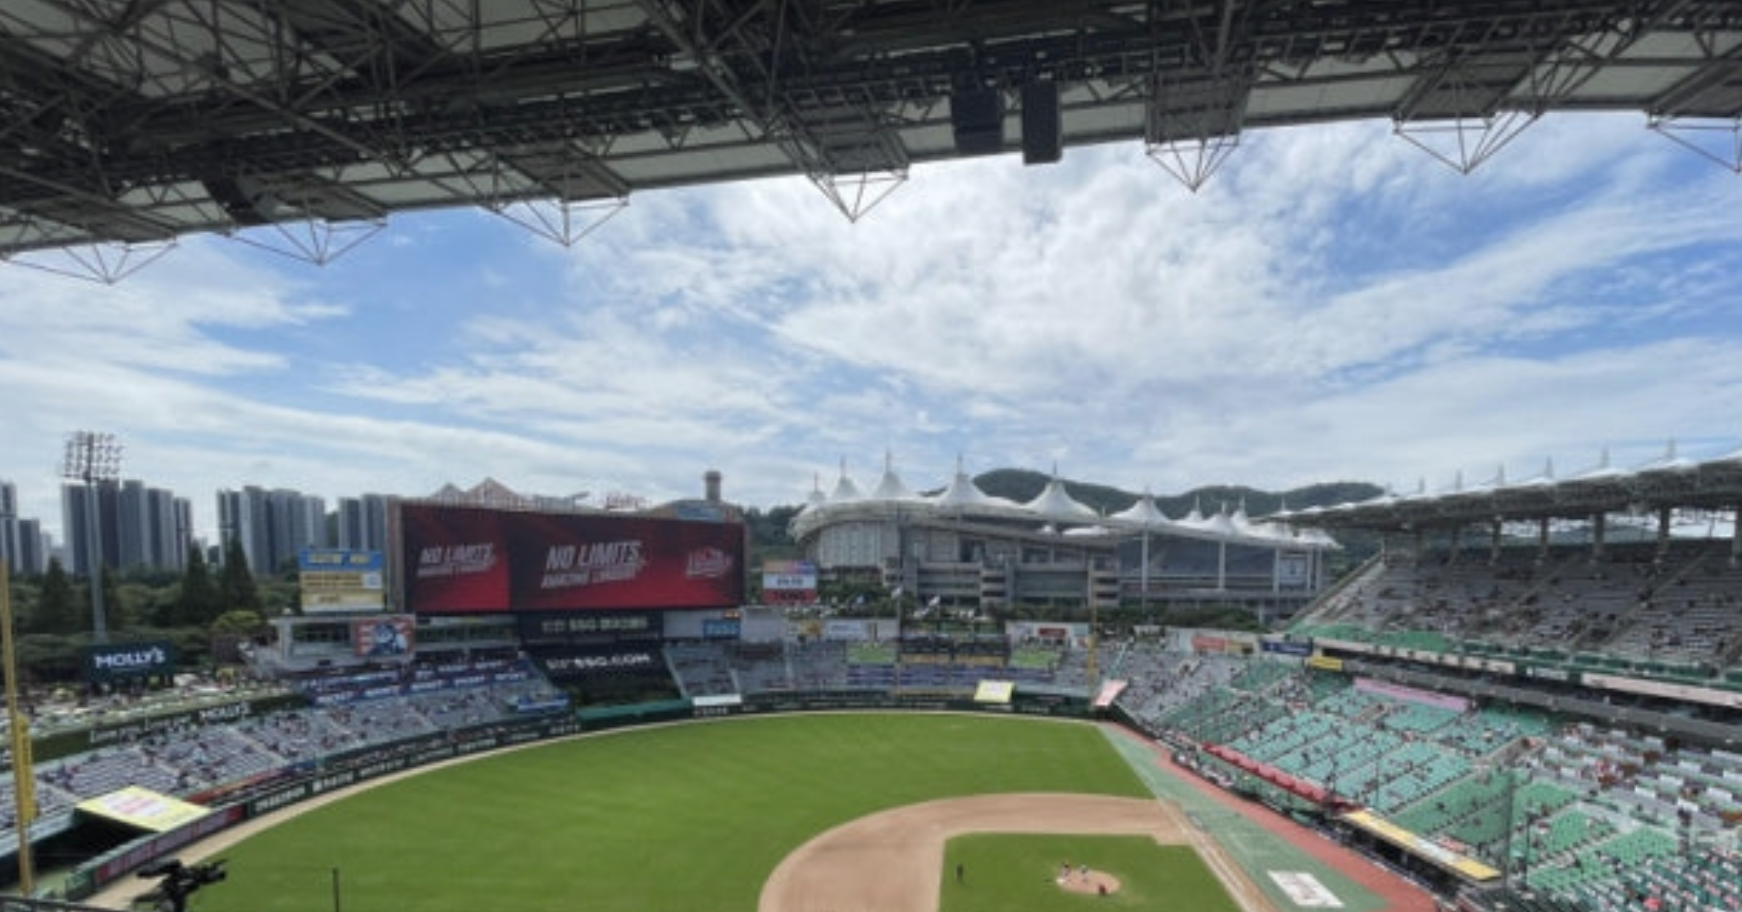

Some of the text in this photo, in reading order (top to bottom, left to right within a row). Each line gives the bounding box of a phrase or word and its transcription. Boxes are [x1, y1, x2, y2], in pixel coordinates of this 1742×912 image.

[420, 546, 442, 564] NO
[546, 544, 576, 571] NO
[94, 646, 166, 668] MOLLY'S
